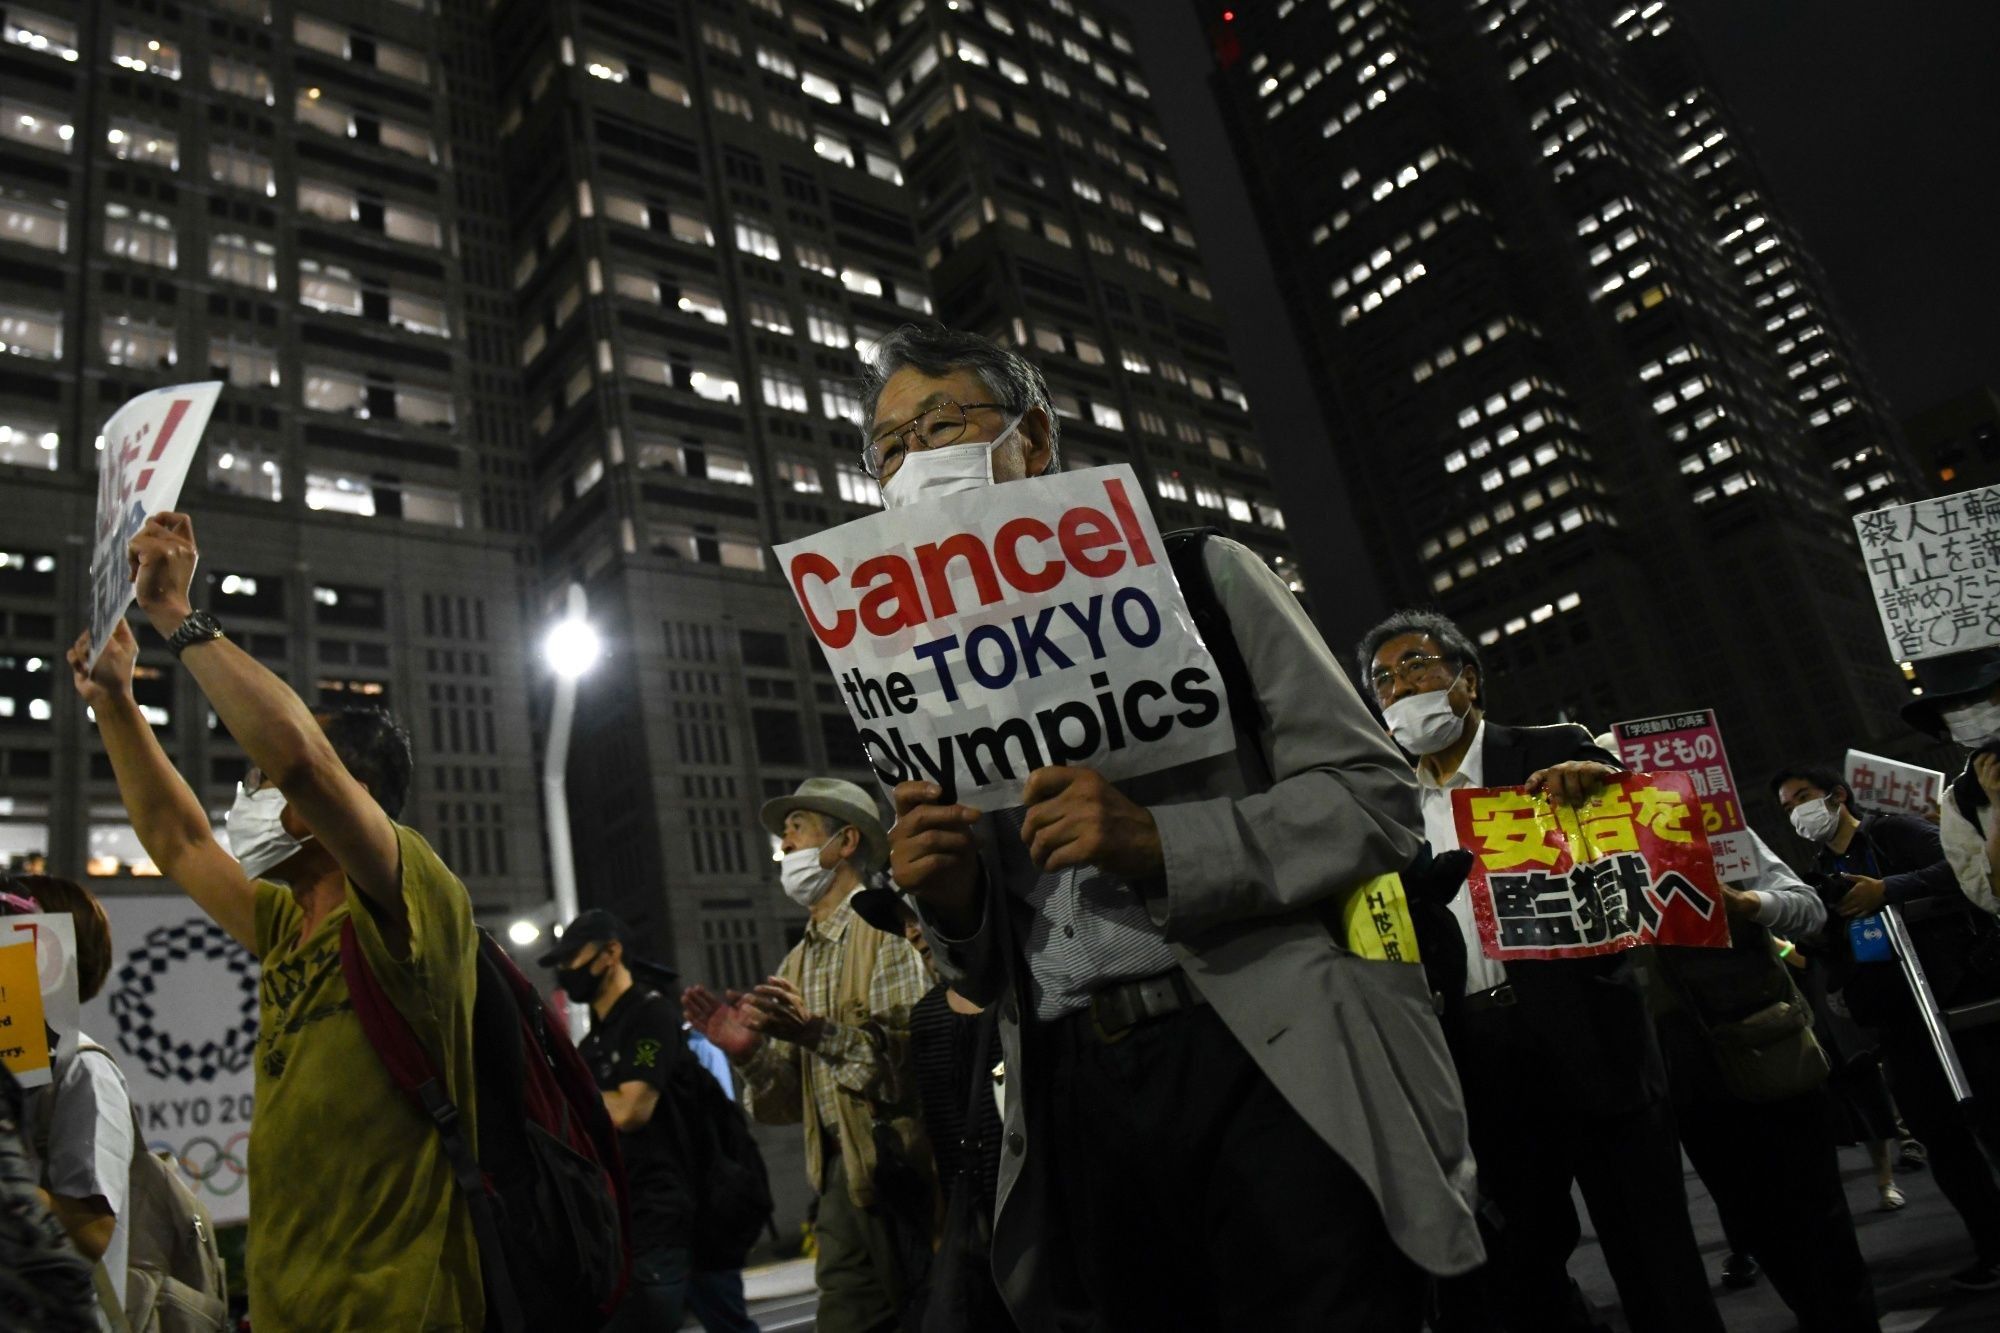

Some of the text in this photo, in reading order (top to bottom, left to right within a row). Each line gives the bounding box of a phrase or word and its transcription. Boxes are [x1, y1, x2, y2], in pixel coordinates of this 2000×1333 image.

[790, 478, 1157, 649] Cancel
[842, 586, 1161, 722] the TOKYO
[862, 666, 1221, 806] Olympics
[1624, 734, 1718, 772] 子どもの
[1469, 782, 1695, 871] 安倍を
[1485, 851, 1716, 950] 監獄へ
